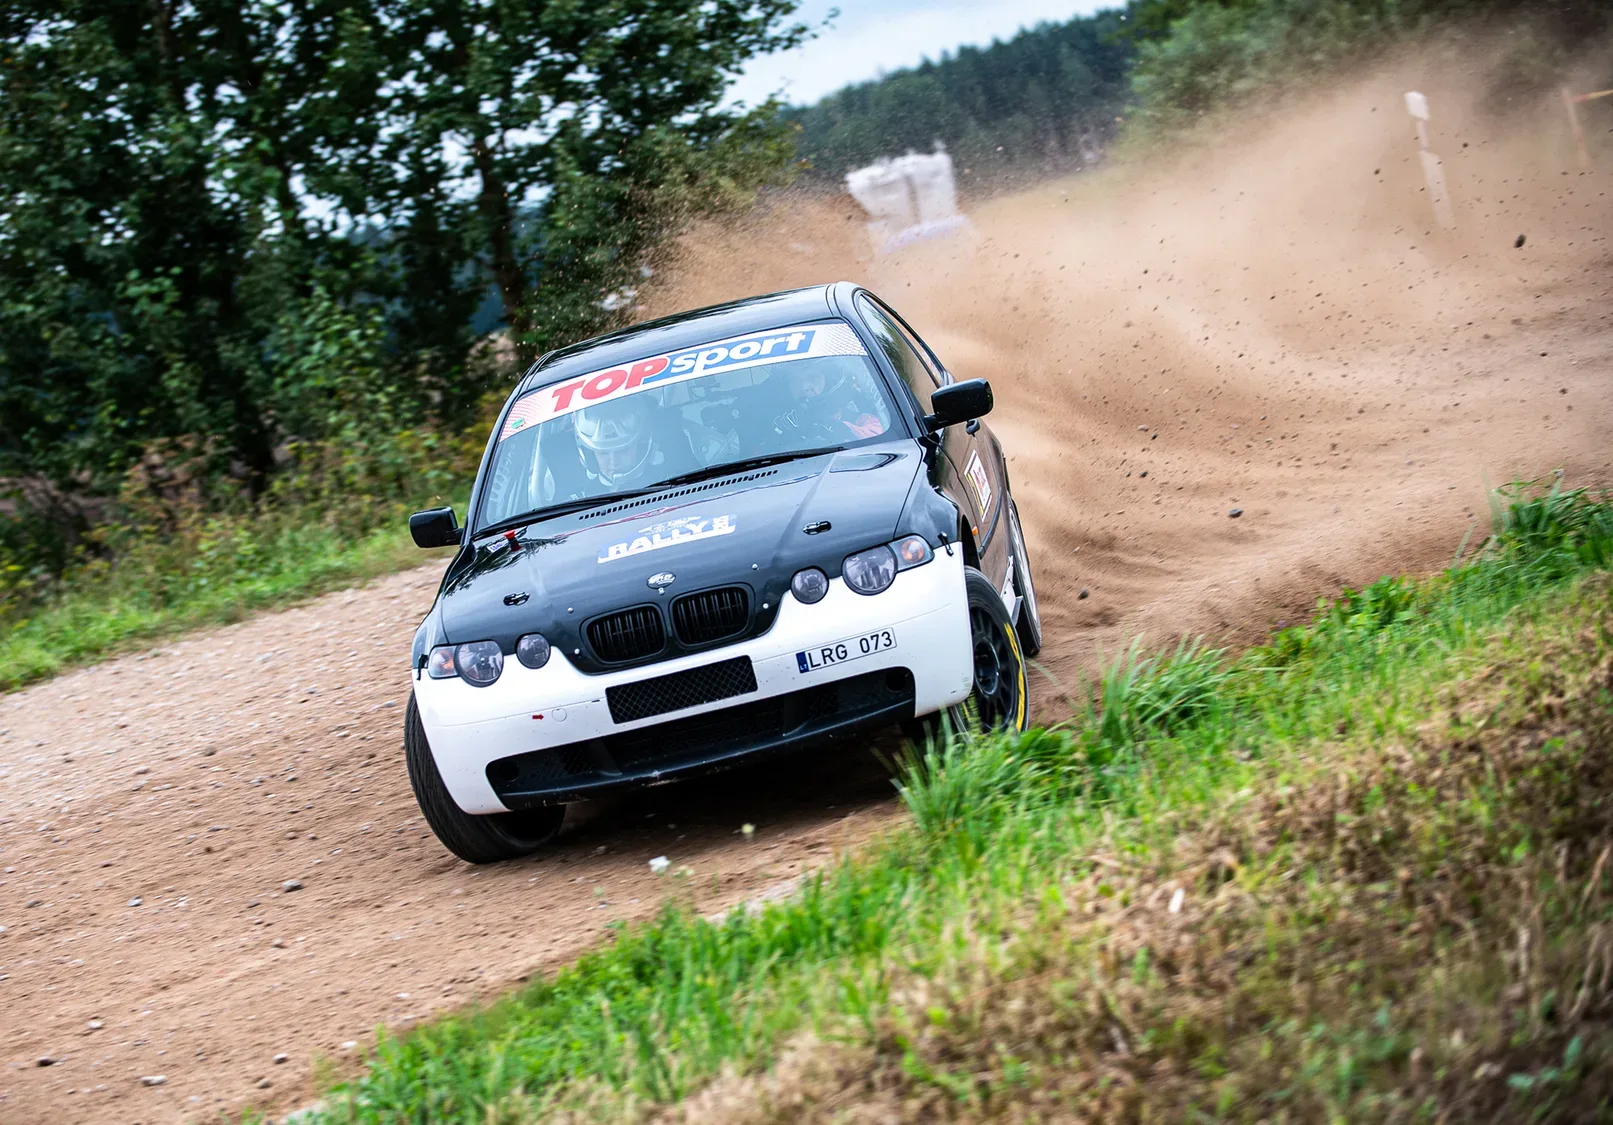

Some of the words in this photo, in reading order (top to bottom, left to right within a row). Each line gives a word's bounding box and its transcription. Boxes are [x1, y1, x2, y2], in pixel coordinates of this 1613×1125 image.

[608, 520, 709, 557] RALLY
[799, 663, 808, 671] LT
[808, 644, 848, 668] LRG
[859, 631, 893, 654] 073
